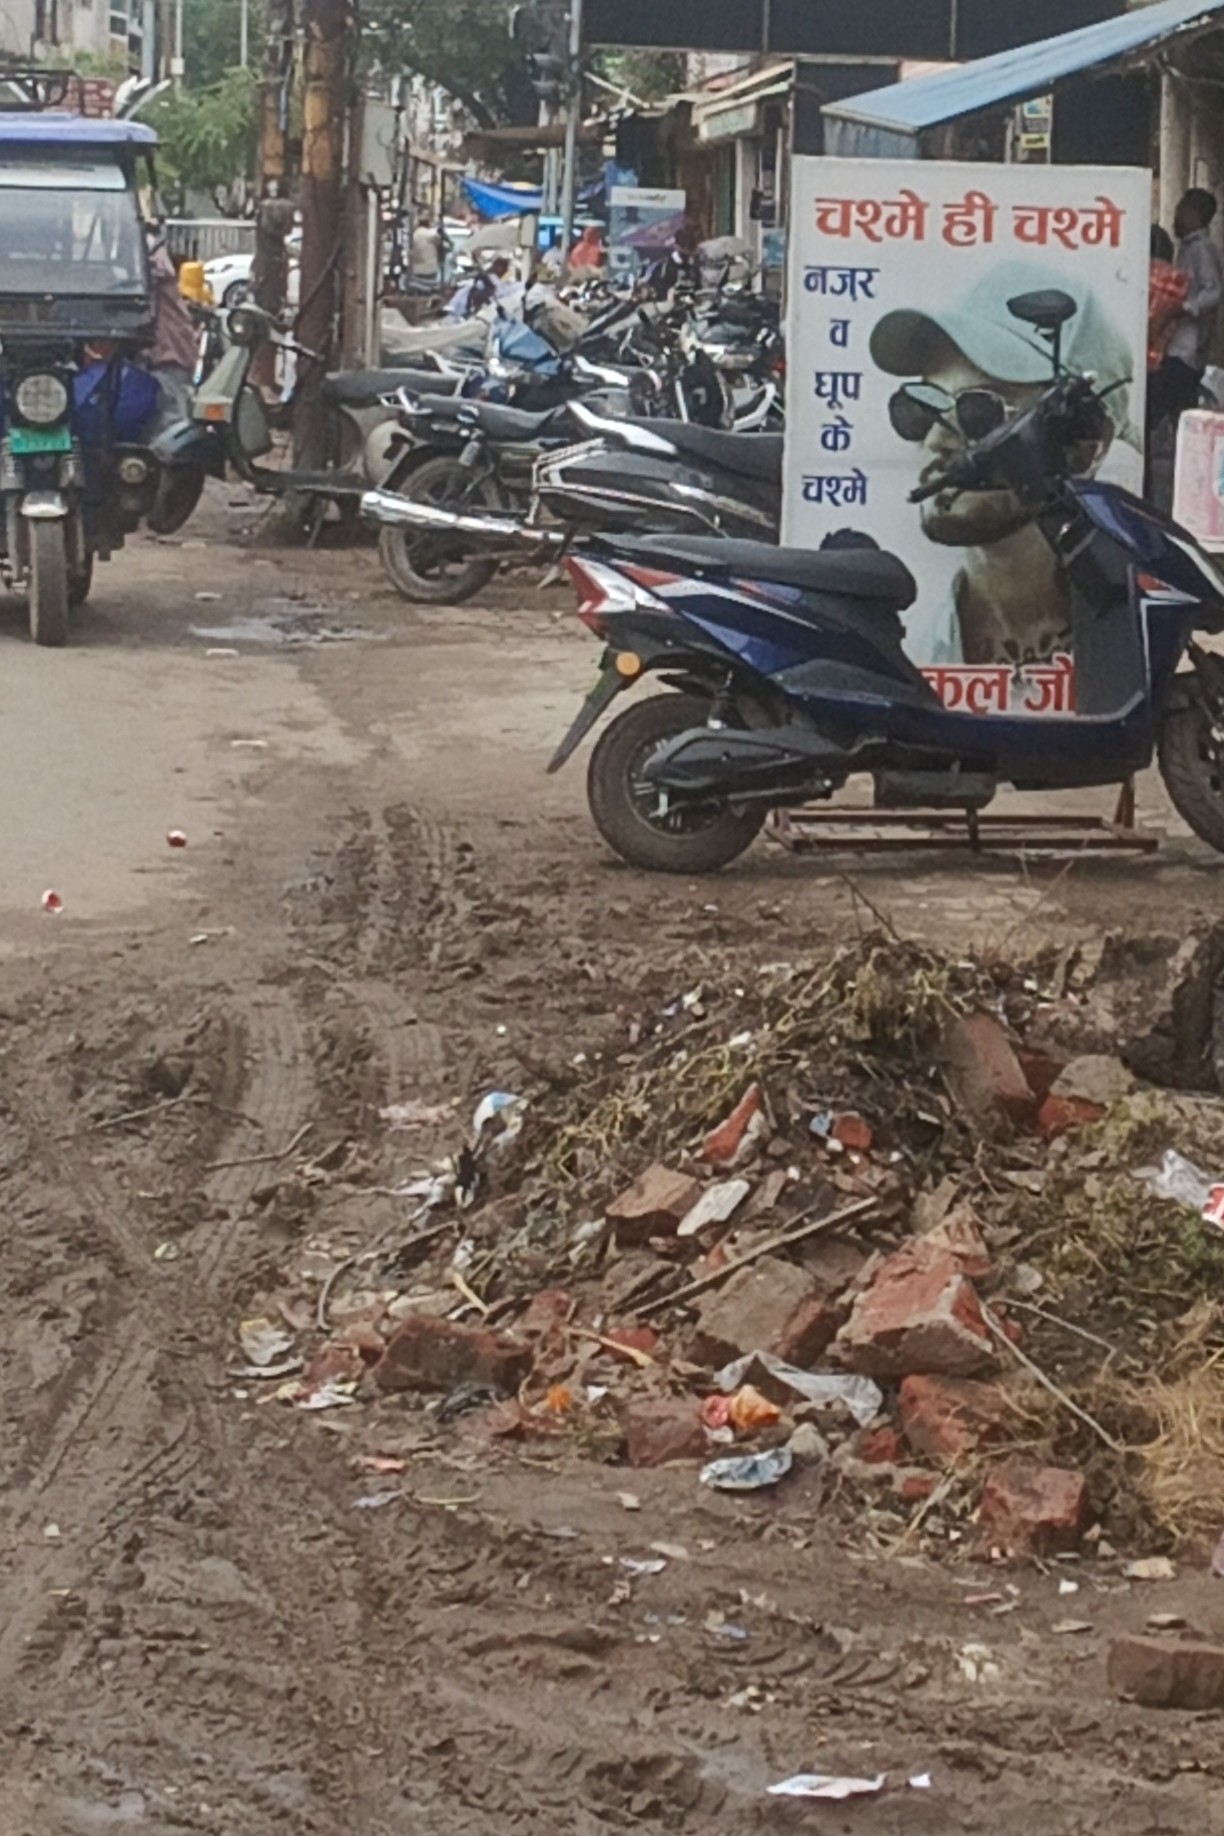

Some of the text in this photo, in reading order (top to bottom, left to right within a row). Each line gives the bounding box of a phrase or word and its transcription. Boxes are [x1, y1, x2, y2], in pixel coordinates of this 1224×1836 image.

[814, 189, 1126, 250] चश्मे ही चश्मे
[829, 318, 851, 348] व
[820, 414, 854, 452] के
[802, 467, 868, 508] चश्मे
